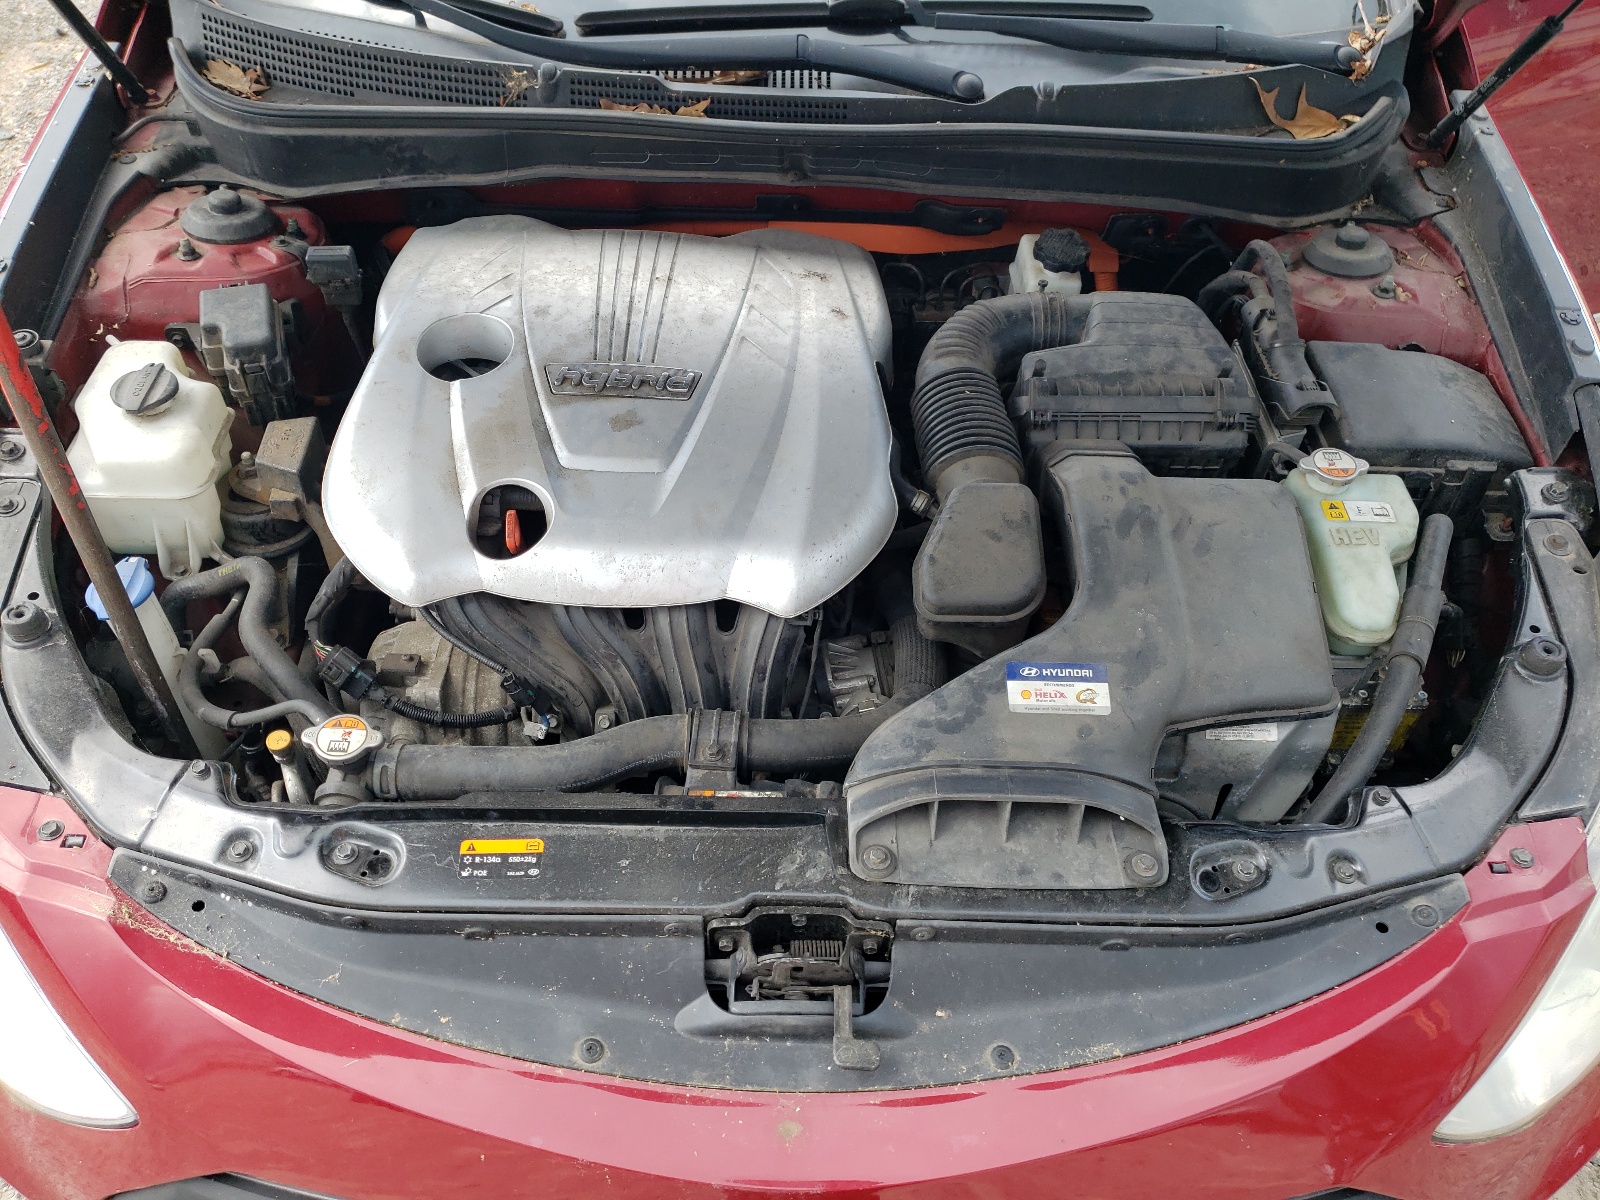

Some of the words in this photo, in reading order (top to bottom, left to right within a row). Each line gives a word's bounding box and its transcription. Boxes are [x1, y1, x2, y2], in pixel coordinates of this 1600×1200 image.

[554, 366, 695, 393] hybrid
[1329, 527, 1380, 546] HEV
[1042, 668, 1093, 677] HYUNDAI
[1034, 689, 1068, 699] HELIX
